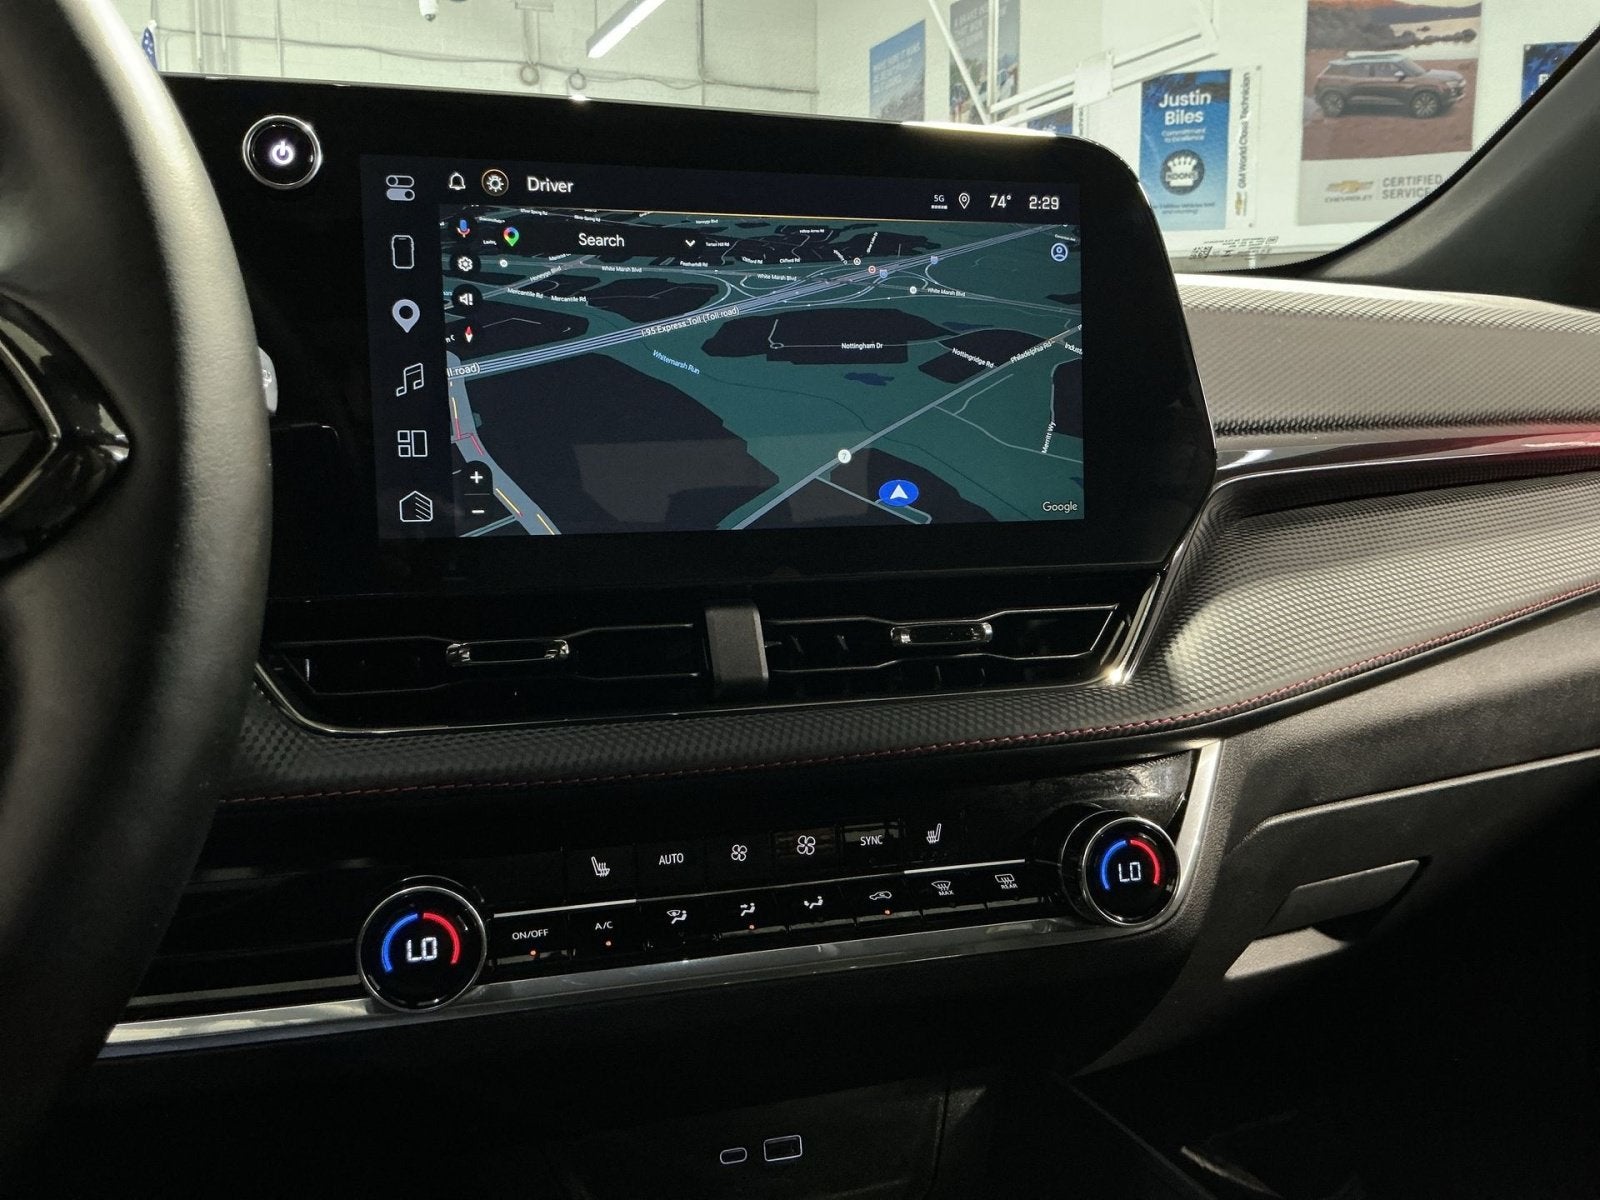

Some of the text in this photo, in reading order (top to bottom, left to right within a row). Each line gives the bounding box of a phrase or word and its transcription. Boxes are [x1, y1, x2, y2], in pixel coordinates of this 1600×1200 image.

[1158, 90, 1212, 108] Justin
[1240, 72, 1251, 119] Technician
[1164, 109, 1204, 126] Biles
[1238, 147, 1248, 172] World
[526, 175, 574, 193] Driver
[1382, 174, 1443, 188] CERTIFIED
[933, 194, 945, 203] 5G
[1382, 187, 1431, 200] SERVICE
[989, 194, 1012, 209] 74°
[1028, 195, 1060, 210] 2:29
[578, 232, 625, 247] Search
[507, 287, 535, 298] Mercantile
[550, 295, 578, 303] Mercantile
[657, 320, 687, 334] Express
[687, 316, 702, 326] Toll
[841, 342, 875, 350] Nottingham
[1010, 340, 1052, 364] Philadelphia Rd
[652, 349, 700, 375] Whitemarsh Run
[952, 347, 995, 369] Nottingridge Rd
[1041, 420, 1057, 454] Merritt Wy
[1042, 501, 1078, 514] Google
[860, 835, 883, 846] SYNC
[658, 852, 685, 865] AUTO
[594, 920, 613, 930] A/C
[511, 928, 549, 940] ON/OFF
